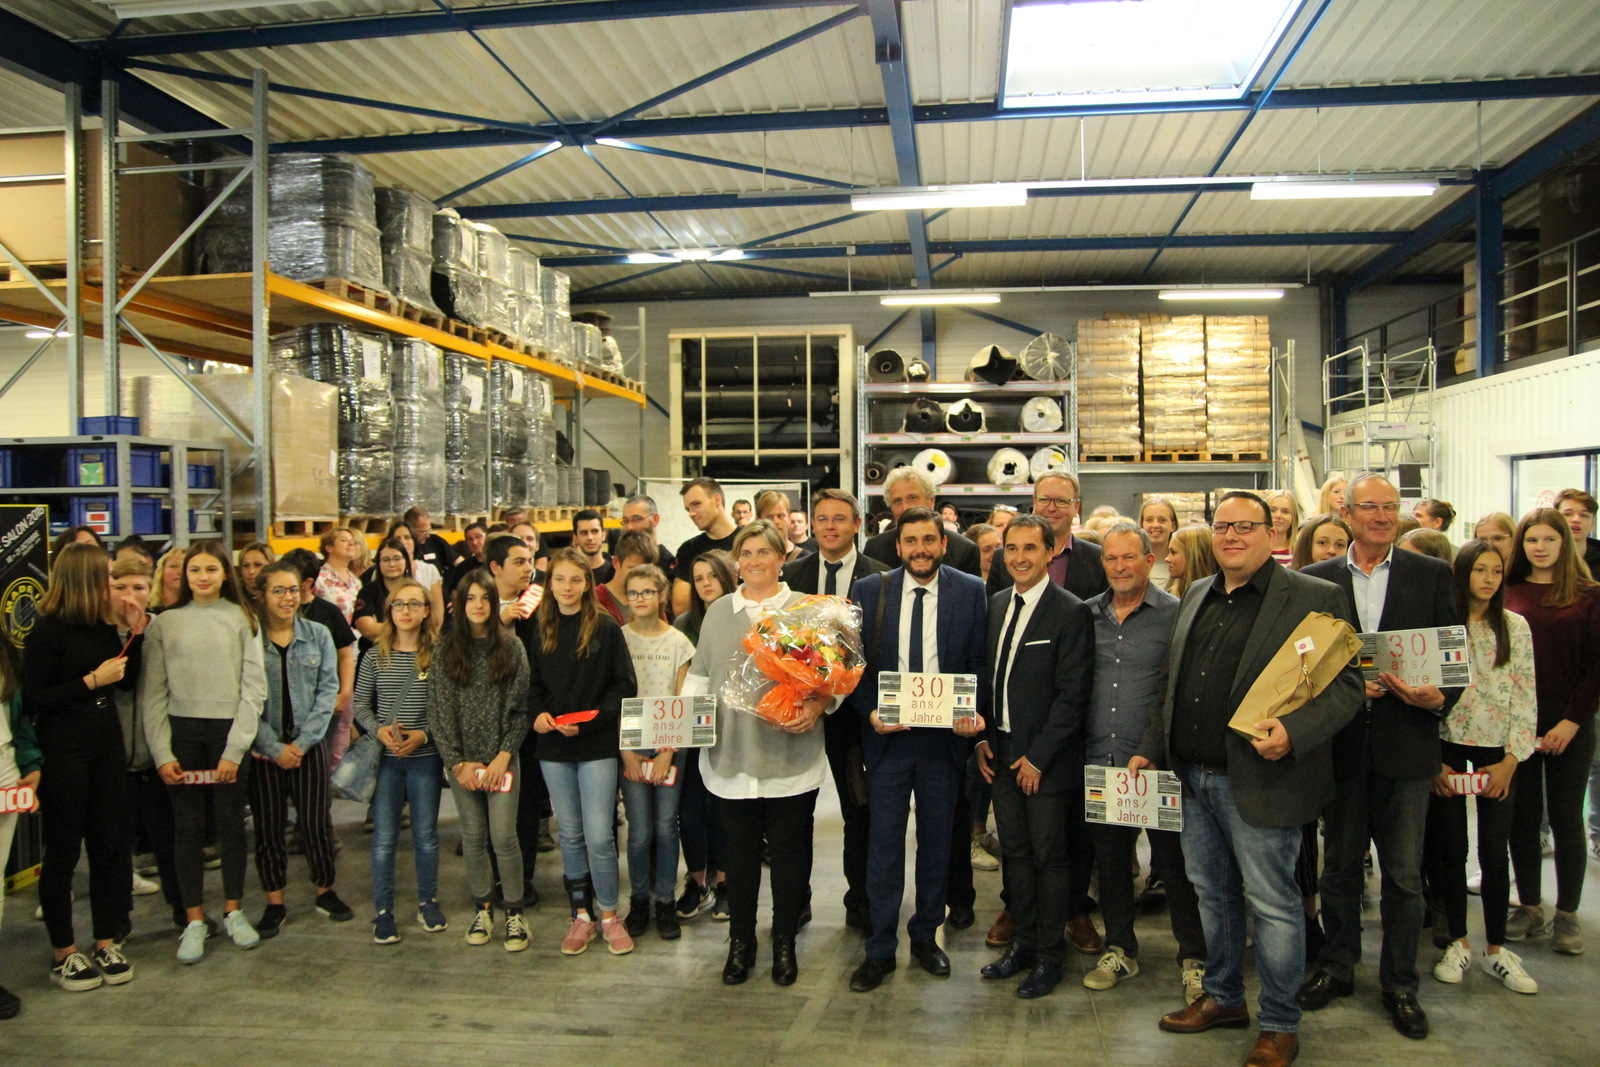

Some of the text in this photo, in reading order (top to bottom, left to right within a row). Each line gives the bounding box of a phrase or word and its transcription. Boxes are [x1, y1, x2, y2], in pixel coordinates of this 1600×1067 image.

[1, 518, 29, 547] SALON
[5, 585, 33, 613] MADE
[1389, 633, 1426, 657] 30
[912, 676, 943, 698] 30
[653, 699, 684, 720] 30
[911, 700, 943, 709] ans/
[652, 722, 683, 731] ans/
[911, 712, 943, 724] Jahre
[652, 733, 683, 744] Jahre
[1116, 772, 1148, 796] 30
[1116, 797, 1148, 809] ans/
[1117, 810, 1148, 824] Jahre
